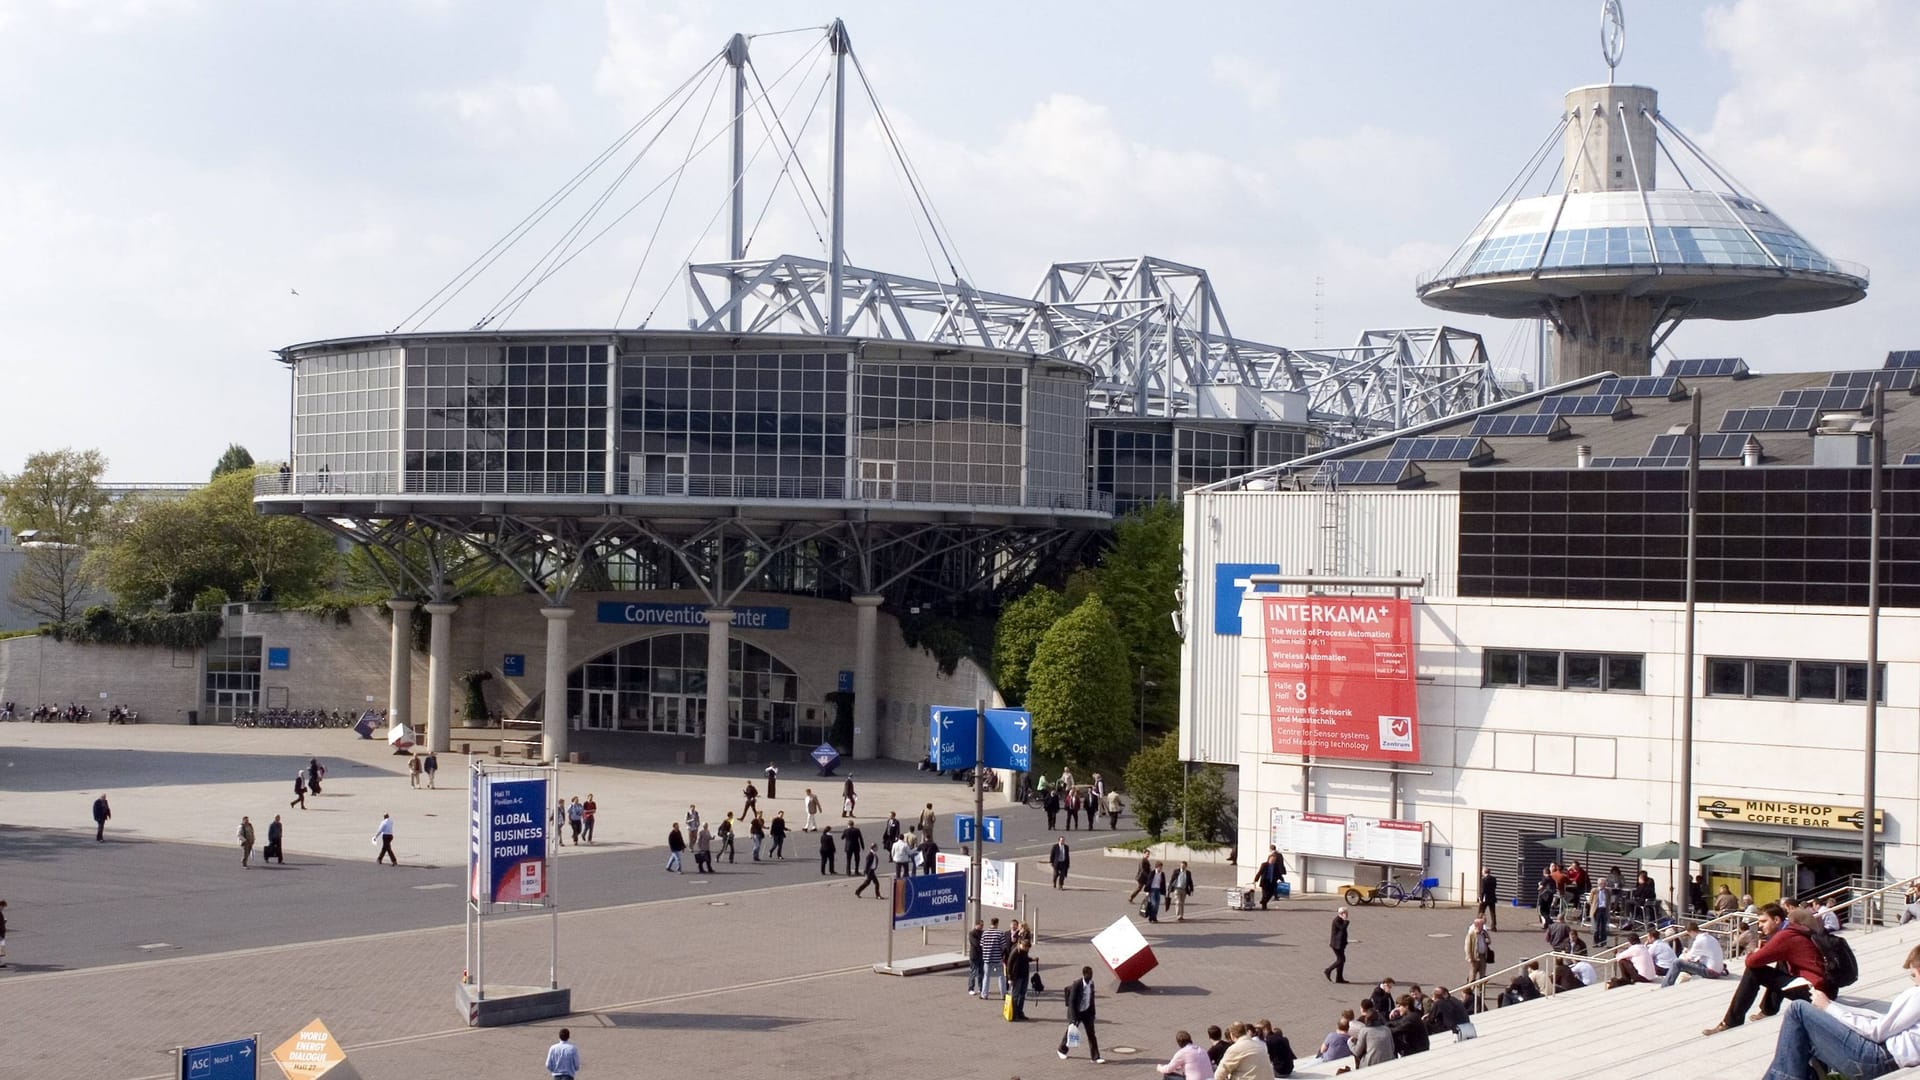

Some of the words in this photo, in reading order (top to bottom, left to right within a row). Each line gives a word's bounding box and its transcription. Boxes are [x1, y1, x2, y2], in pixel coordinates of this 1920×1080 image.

[624, 604, 709, 625] Conventio
[729, 611, 767, 627] enter
[1270, 627, 1283, 635] The
[1285, 628, 1306, 636] World
[1308, 628, 1315, 636] of
[1316, 629, 1346, 637] Process
[1347, 630, 1391, 639] Automation
[1272, 651, 1304, 660] Wireless
[1305, 653, 1347, 662] Automation
[1274, 682, 1291, 690] Halle
[1295, 682, 1308, 701] 8
[1275, 691, 1290, 700] Hall
[1276, 705, 1307, 715] Zentrum
[1308, 706, 1318, 715] für
[1320, 707, 1353, 717] Sensorik
[1277, 715, 1290, 723] und
[1292, 716, 1337, 725] Messtechnik
[1277, 728, 1301, 736] Centre
[1302, 729, 1312, 737] for
[1313, 729, 1338, 738] Sensor
[1340, 731, 1370, 741] systems
[941, 743, 955, 753] Süd
[1012, 743, 1028, 754] Ost
[1278, 737, 1291, 745] and
[1292, 737, 1329, 748] Measuring
[1330, 740, 1370, 751] technology
[941, 755, 962, 767] South
[1009, 756, 1028, 767] East
[1745, 801, 1833, 816] MINI-SHOP
[494, 812, 533, 826] GLOBAL
[1747, 814, 1799, 826] COFFEE
[1803, 818, 1830, 828] BAR
[494, 827, 542, 842] BUSINESS
[494, 844, 529, 858] FORUM
[931, 893, 958, 905] KOREA
[299, 1031, 328, 1041] WORLD
[295, 1041, 326, 1052] ENERGY
[191, 1058, 209, 1071] ASC
[214, 1055, 229, 1065] Nord
[288, 1052, 328, 1063] DIALOGUE
[293, 1063, 308, 1071] Hall
